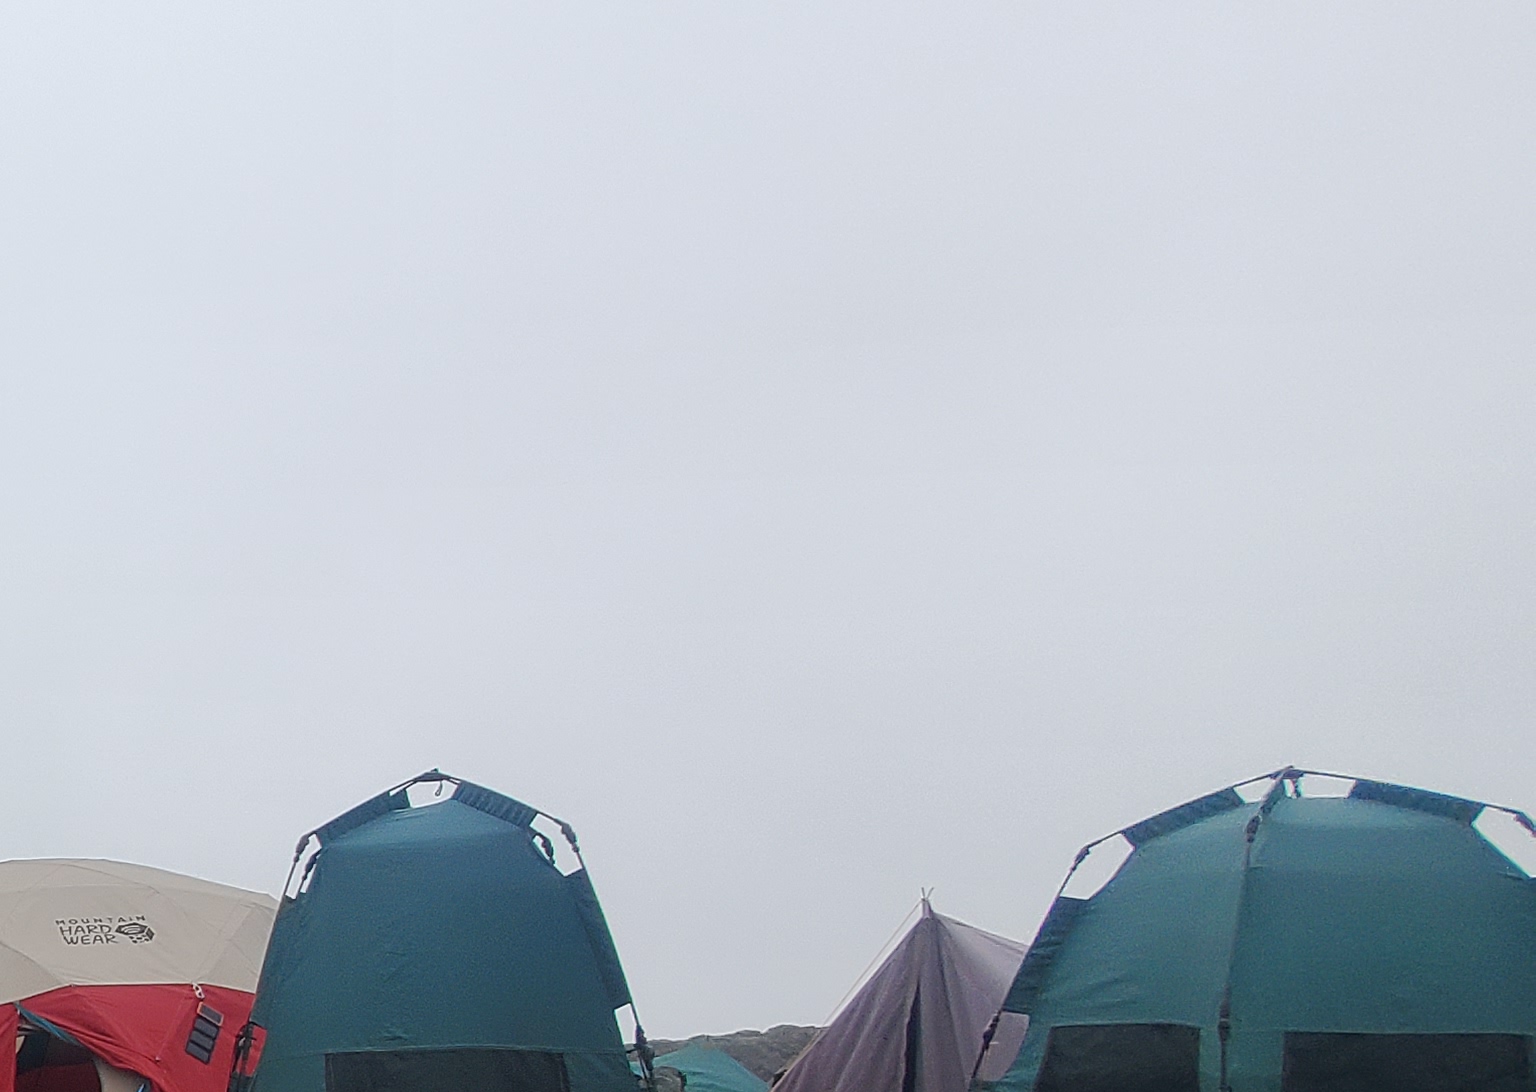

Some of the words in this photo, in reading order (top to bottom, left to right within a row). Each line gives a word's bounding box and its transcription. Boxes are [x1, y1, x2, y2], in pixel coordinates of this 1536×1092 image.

[55, 915, 146, 926] MOUNTAIN
[59, 925, 112, 935] HARD
[63, 934, 118, 945] WEAR
